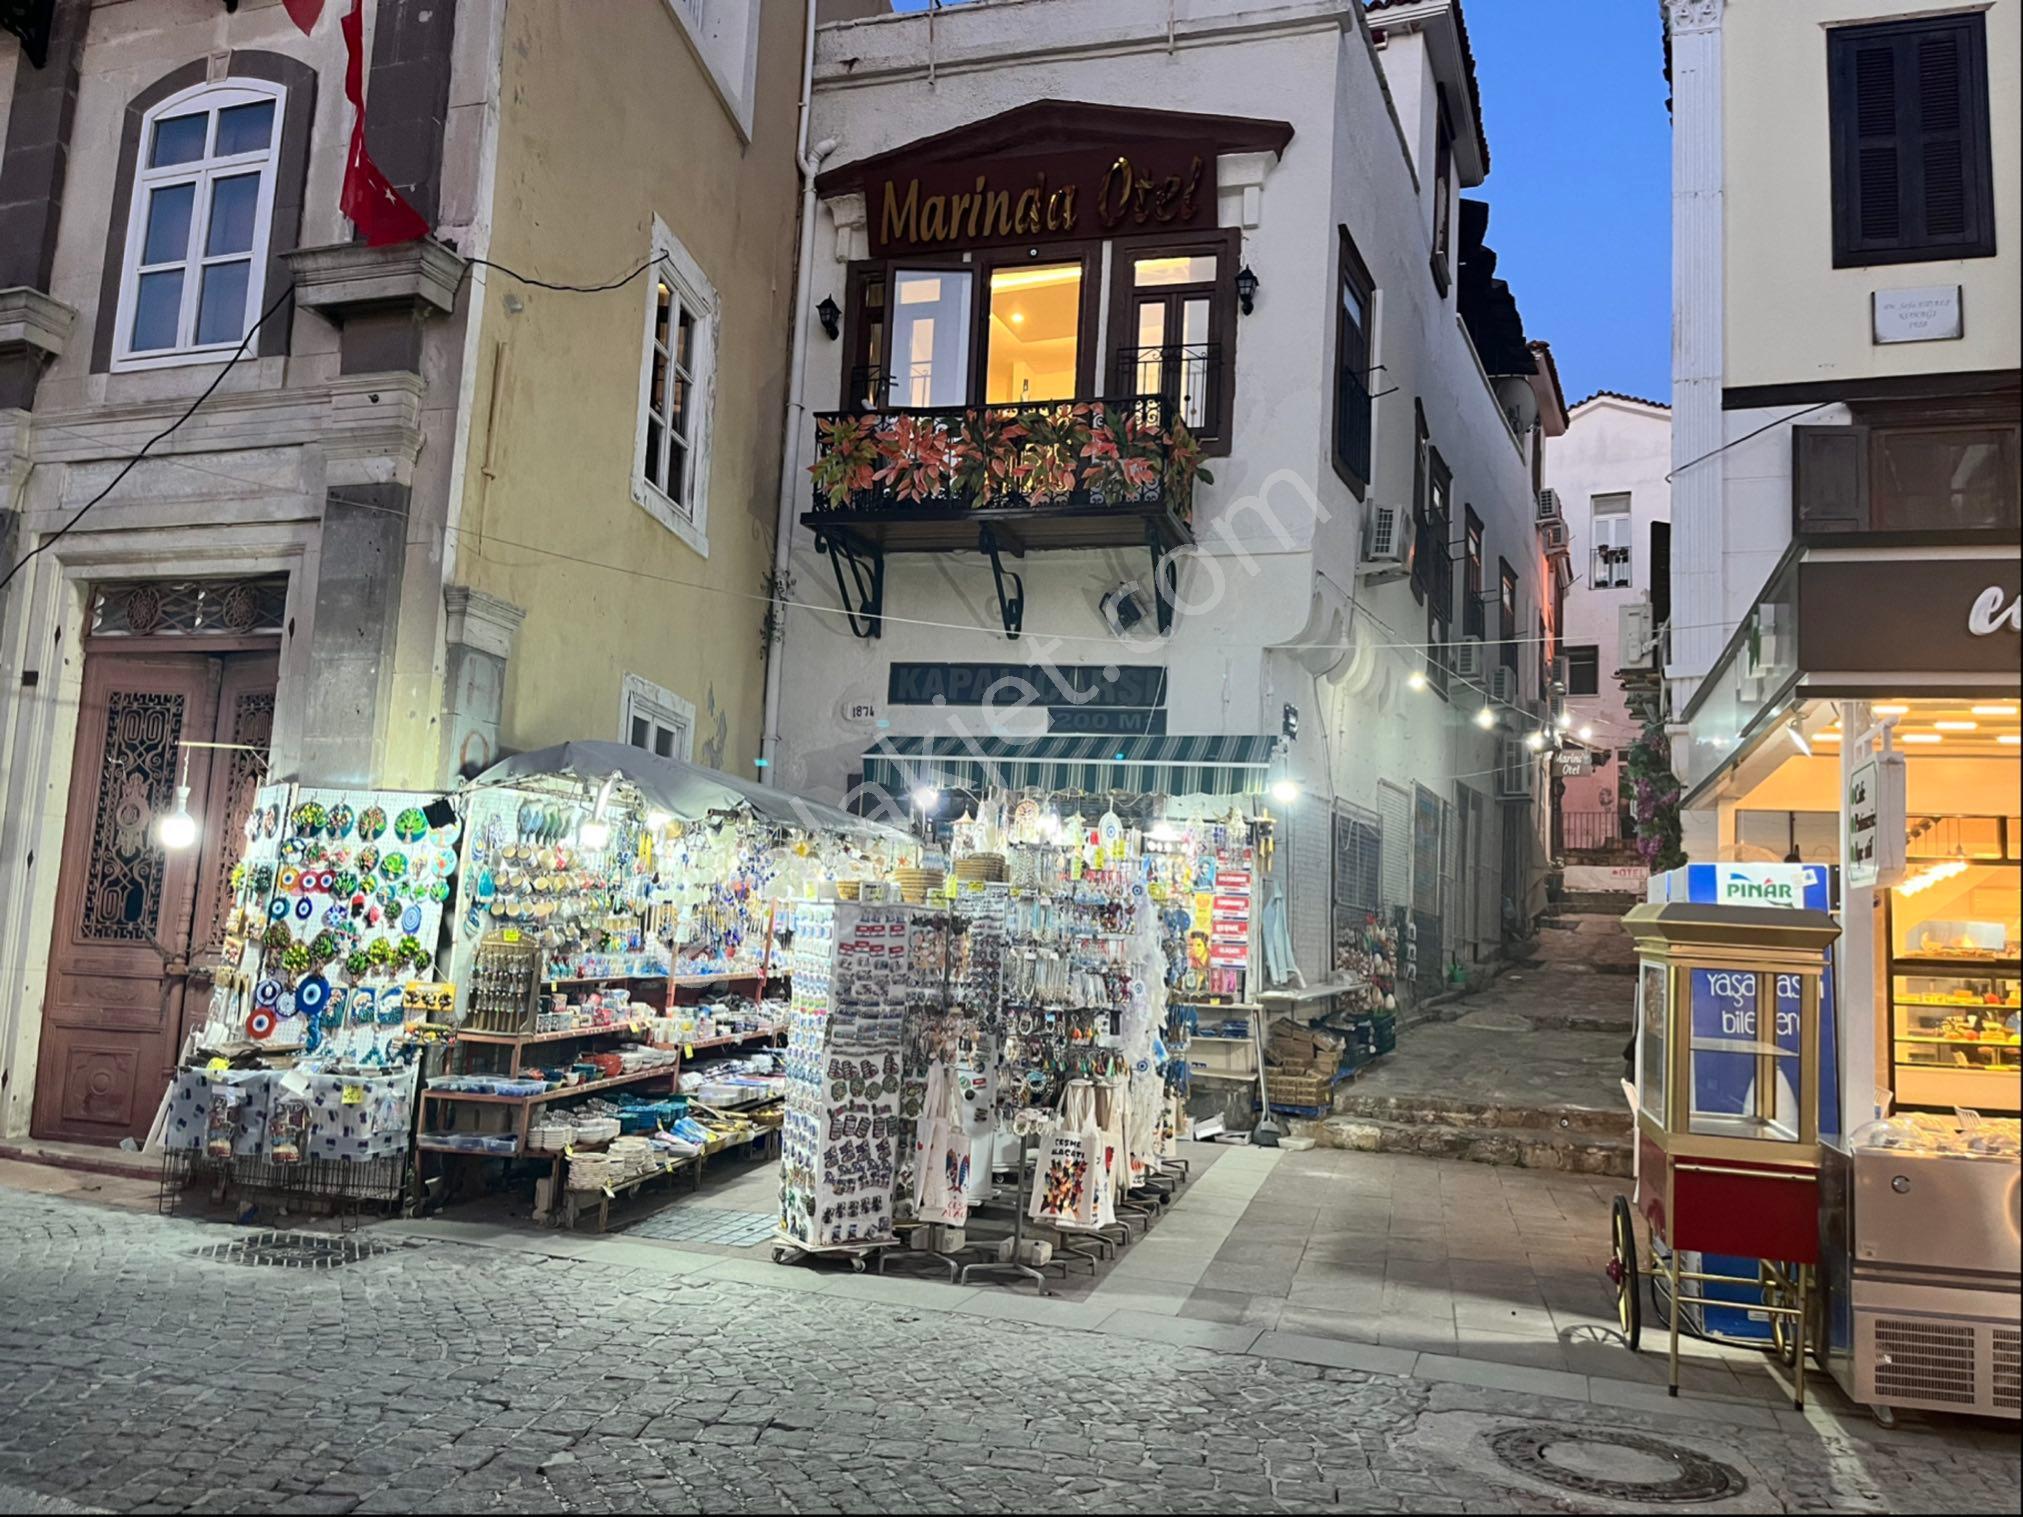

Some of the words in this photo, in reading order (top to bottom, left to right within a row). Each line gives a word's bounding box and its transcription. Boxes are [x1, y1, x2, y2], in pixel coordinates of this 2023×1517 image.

[880, 172, 1079, 245] Marinda
[1098, 155, 1203, 227] Otel
[1727, 883, 1792, 898] PINAR
